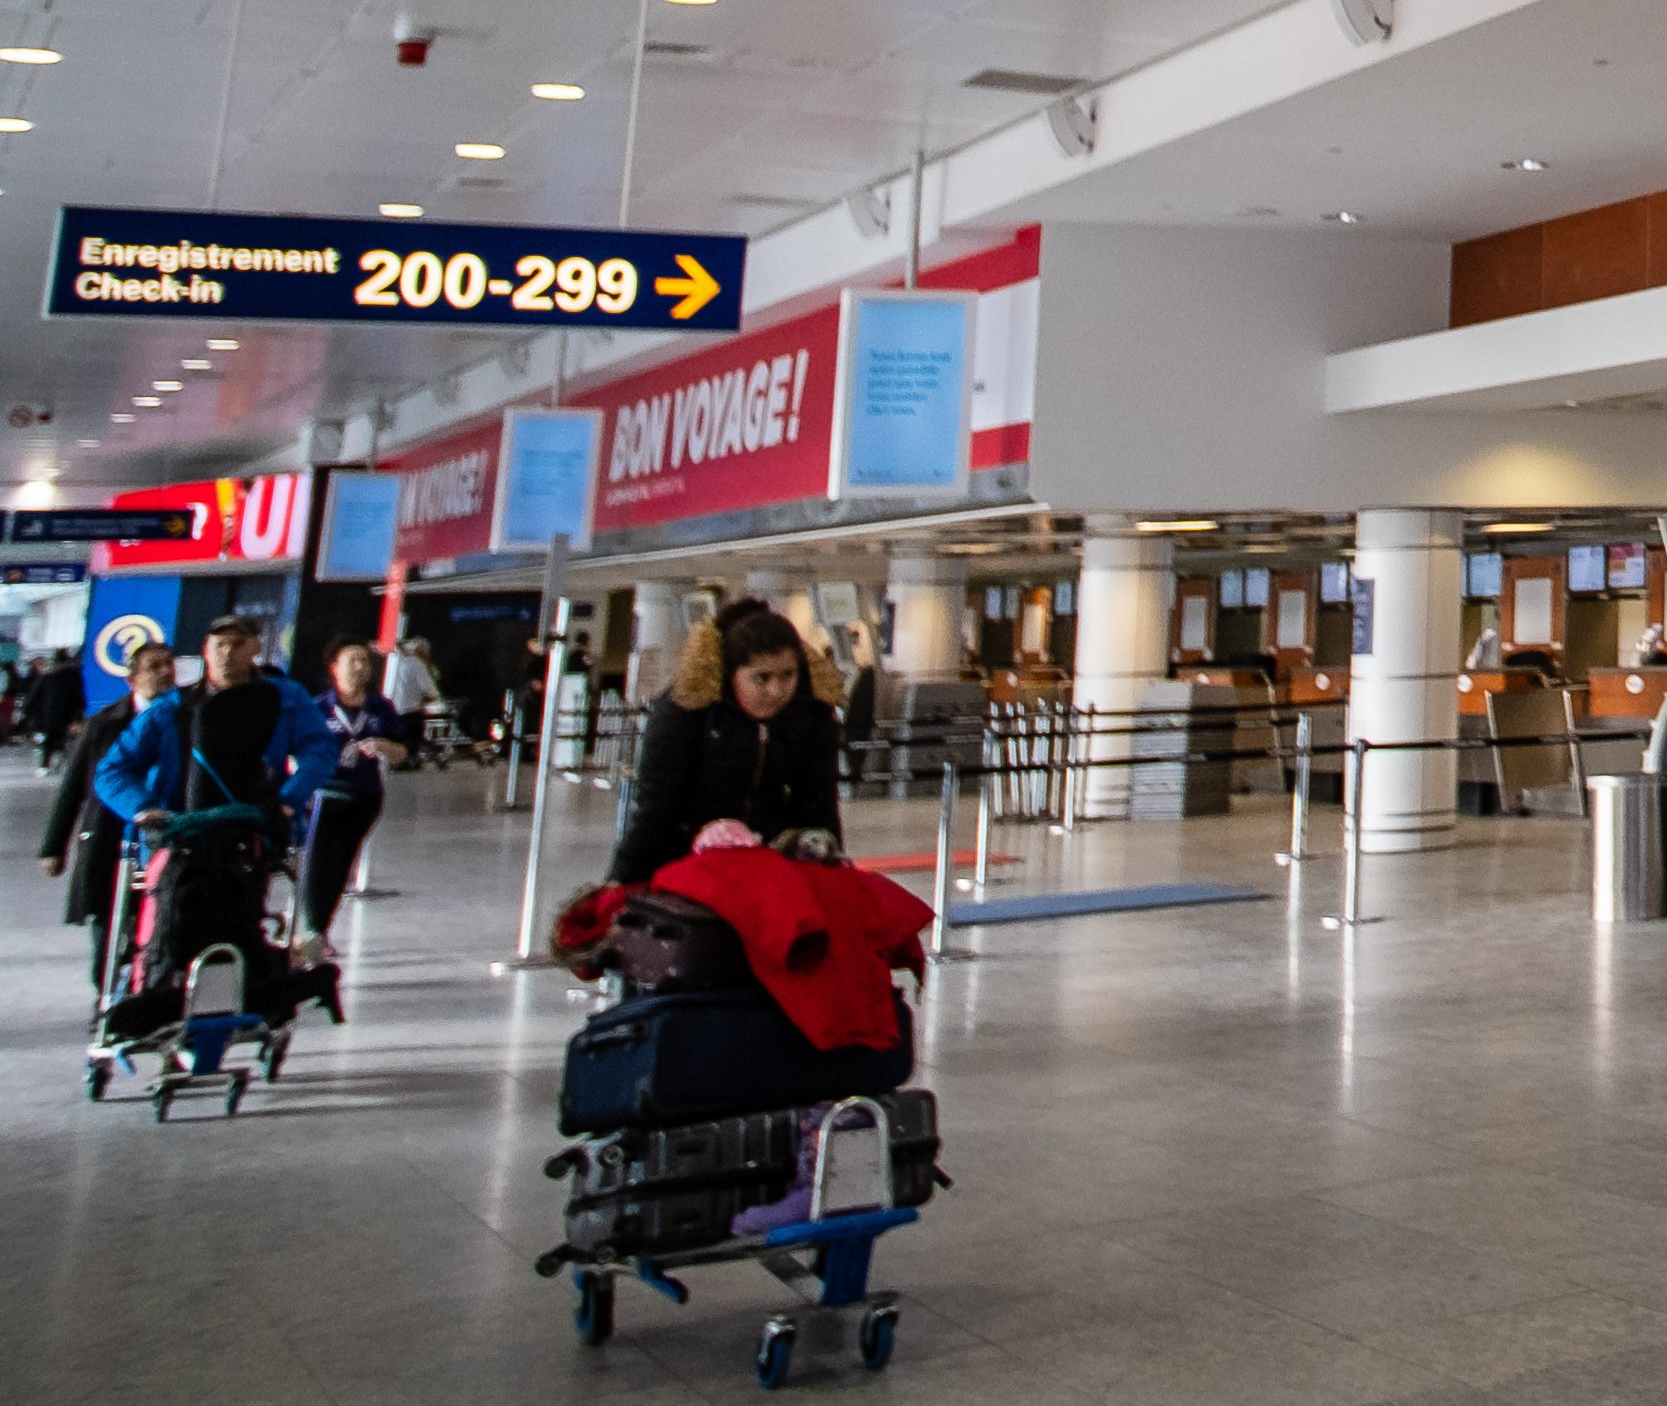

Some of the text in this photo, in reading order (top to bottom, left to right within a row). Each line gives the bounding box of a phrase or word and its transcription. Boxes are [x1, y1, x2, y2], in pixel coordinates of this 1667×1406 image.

[79, 235, 341, 274] Enregistrement
[74, 271, 224, 304] Check-in
[356, 251, 638, 311] 200-299
[609, 394, 671, 482] BON
[671, 349, 810, 469] VOYAGE!
